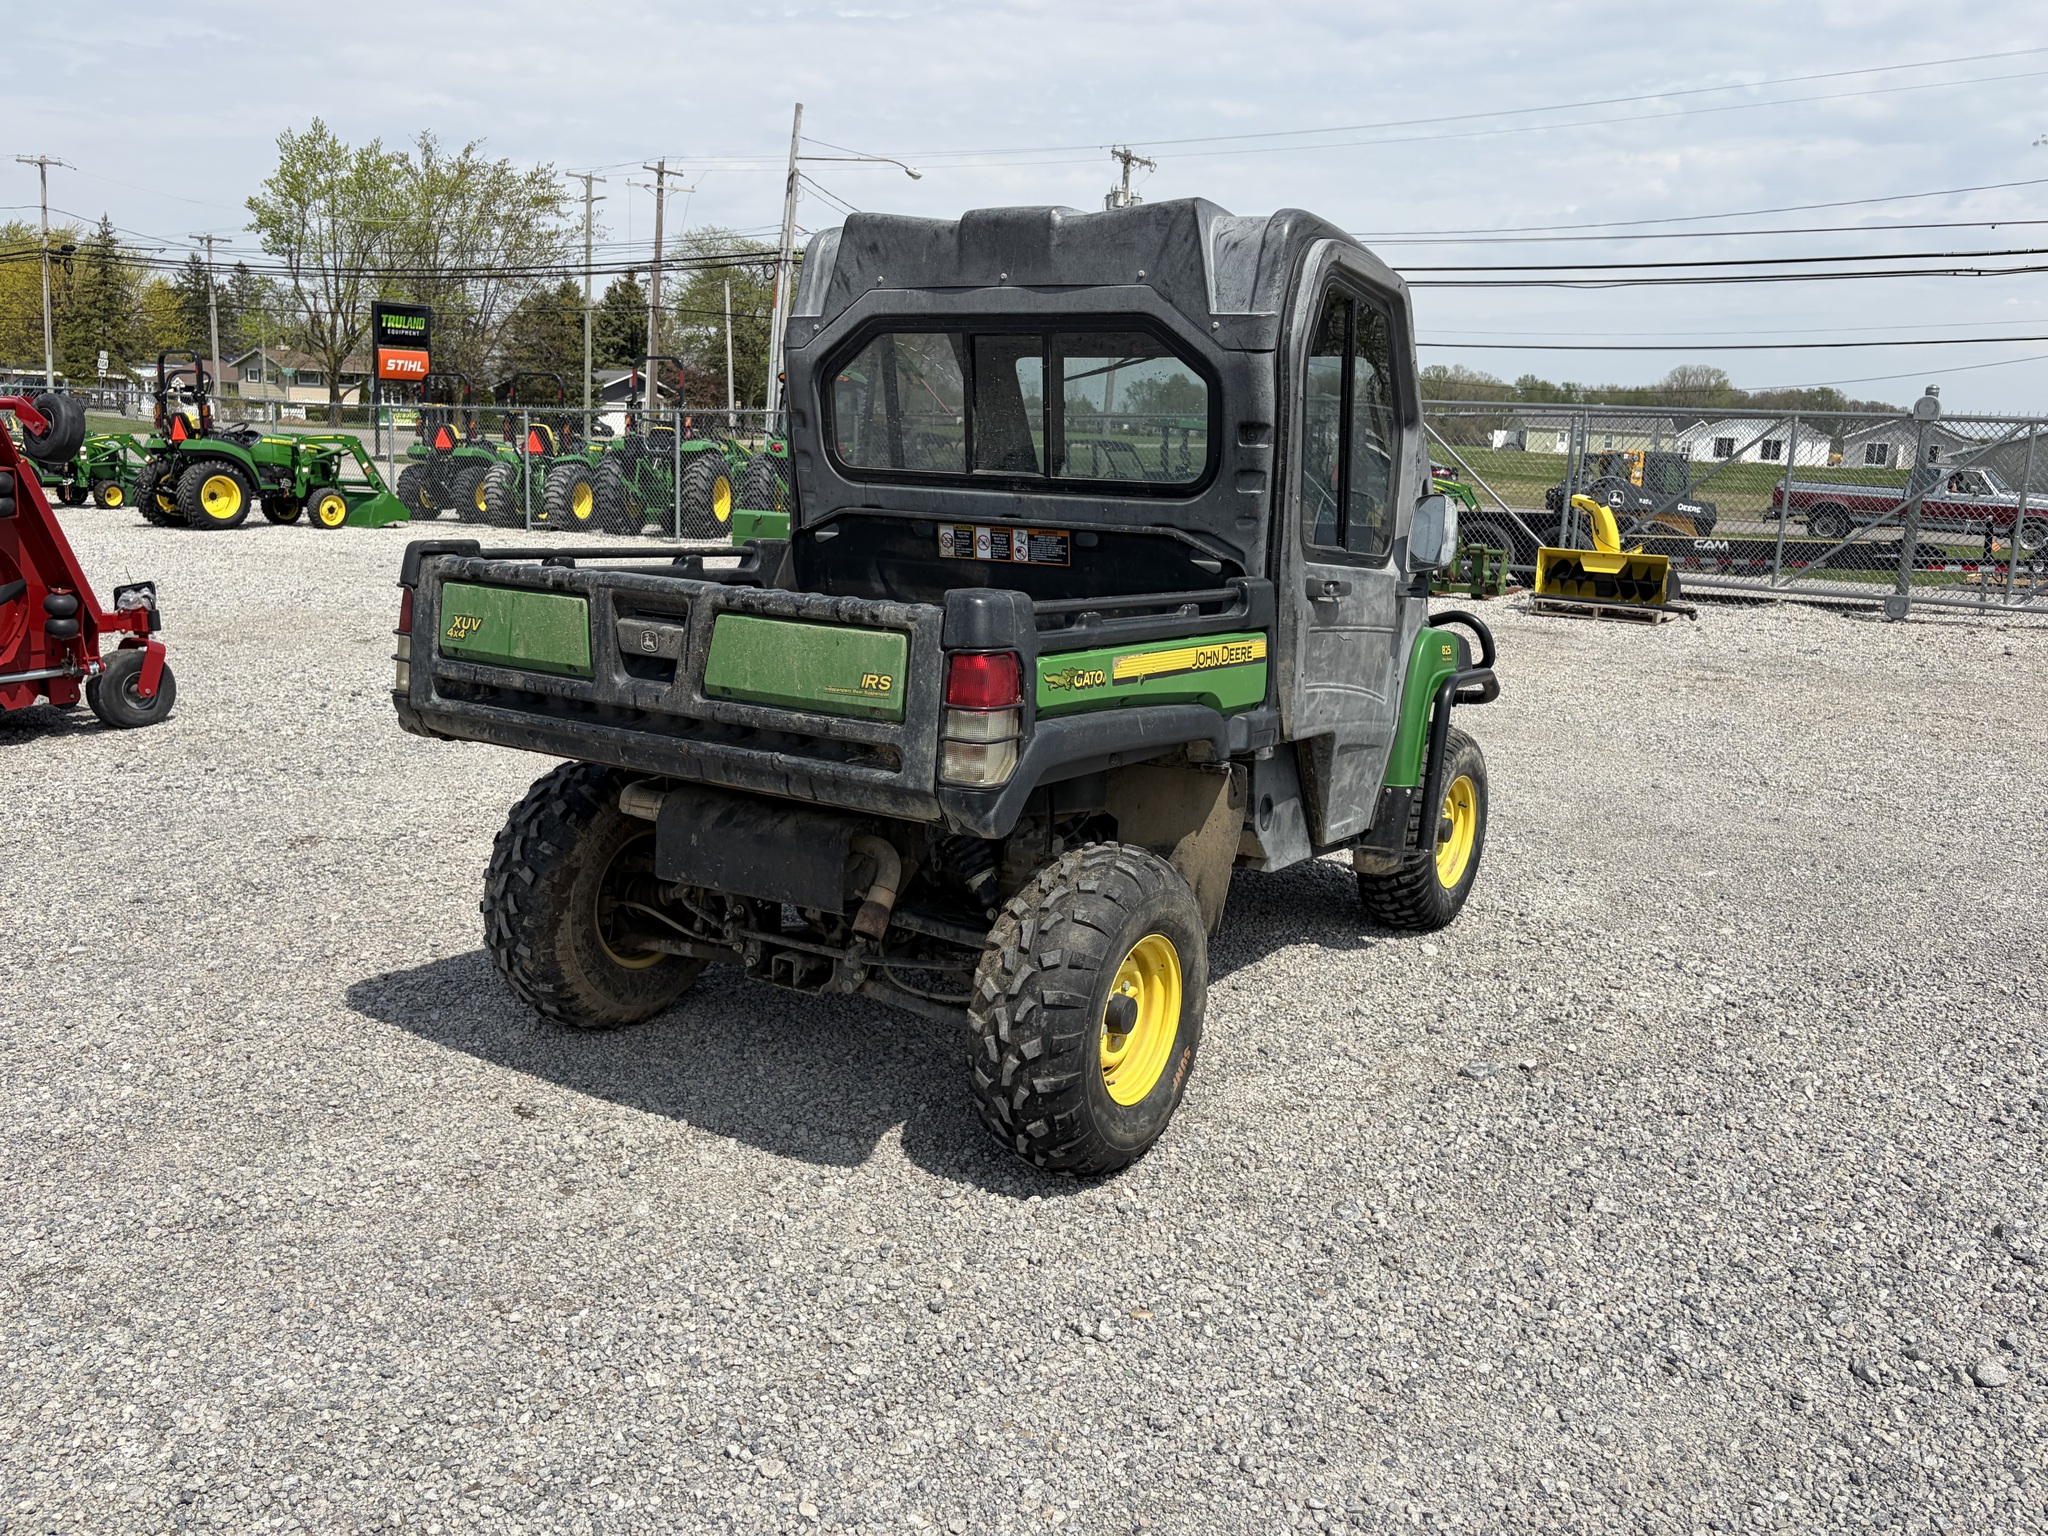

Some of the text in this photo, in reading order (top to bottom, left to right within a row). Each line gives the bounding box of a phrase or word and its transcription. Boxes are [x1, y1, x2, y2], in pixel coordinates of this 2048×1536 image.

[381, 314, 425, 330] TRULAND
[387, 328, 420, 336] EQUIPMENT
[386, 359, 425, 372] STIHL
[1677, 502, 1702, 513] DEERE
[1693, 540, 1729, 552] CAM
[452, 616, 481, 631] XUV
[447, 628, 465, 639] 4x4
[1191, 645, 1254, 669] JOHN DEERE
[861, 674, 892, 691] IRS
